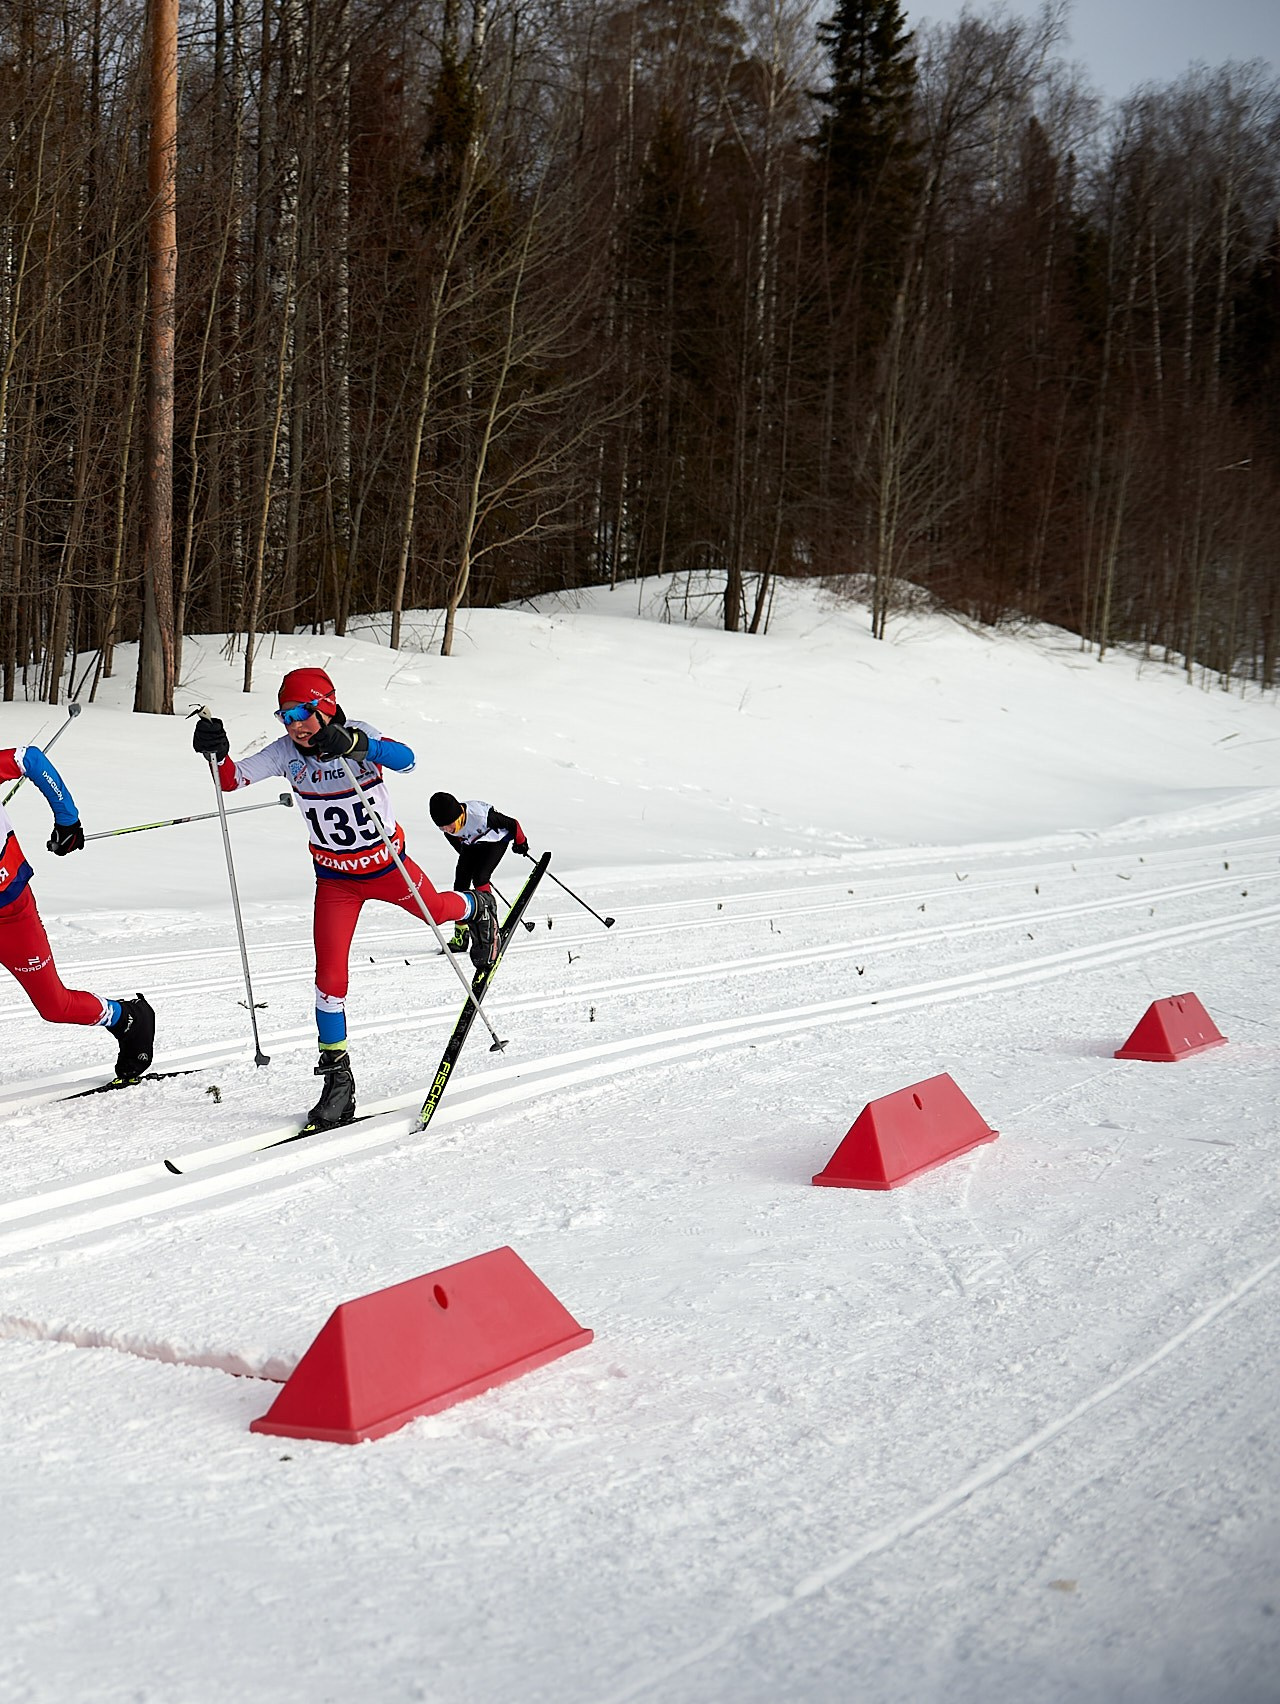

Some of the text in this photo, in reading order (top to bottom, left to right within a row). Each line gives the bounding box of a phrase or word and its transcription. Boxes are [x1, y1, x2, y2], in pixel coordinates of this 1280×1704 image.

[324, 768, 345, 781] ПСБ
[305, 797, 385, 846] 135
[420, 1062, 451, 1123] FISCHER
